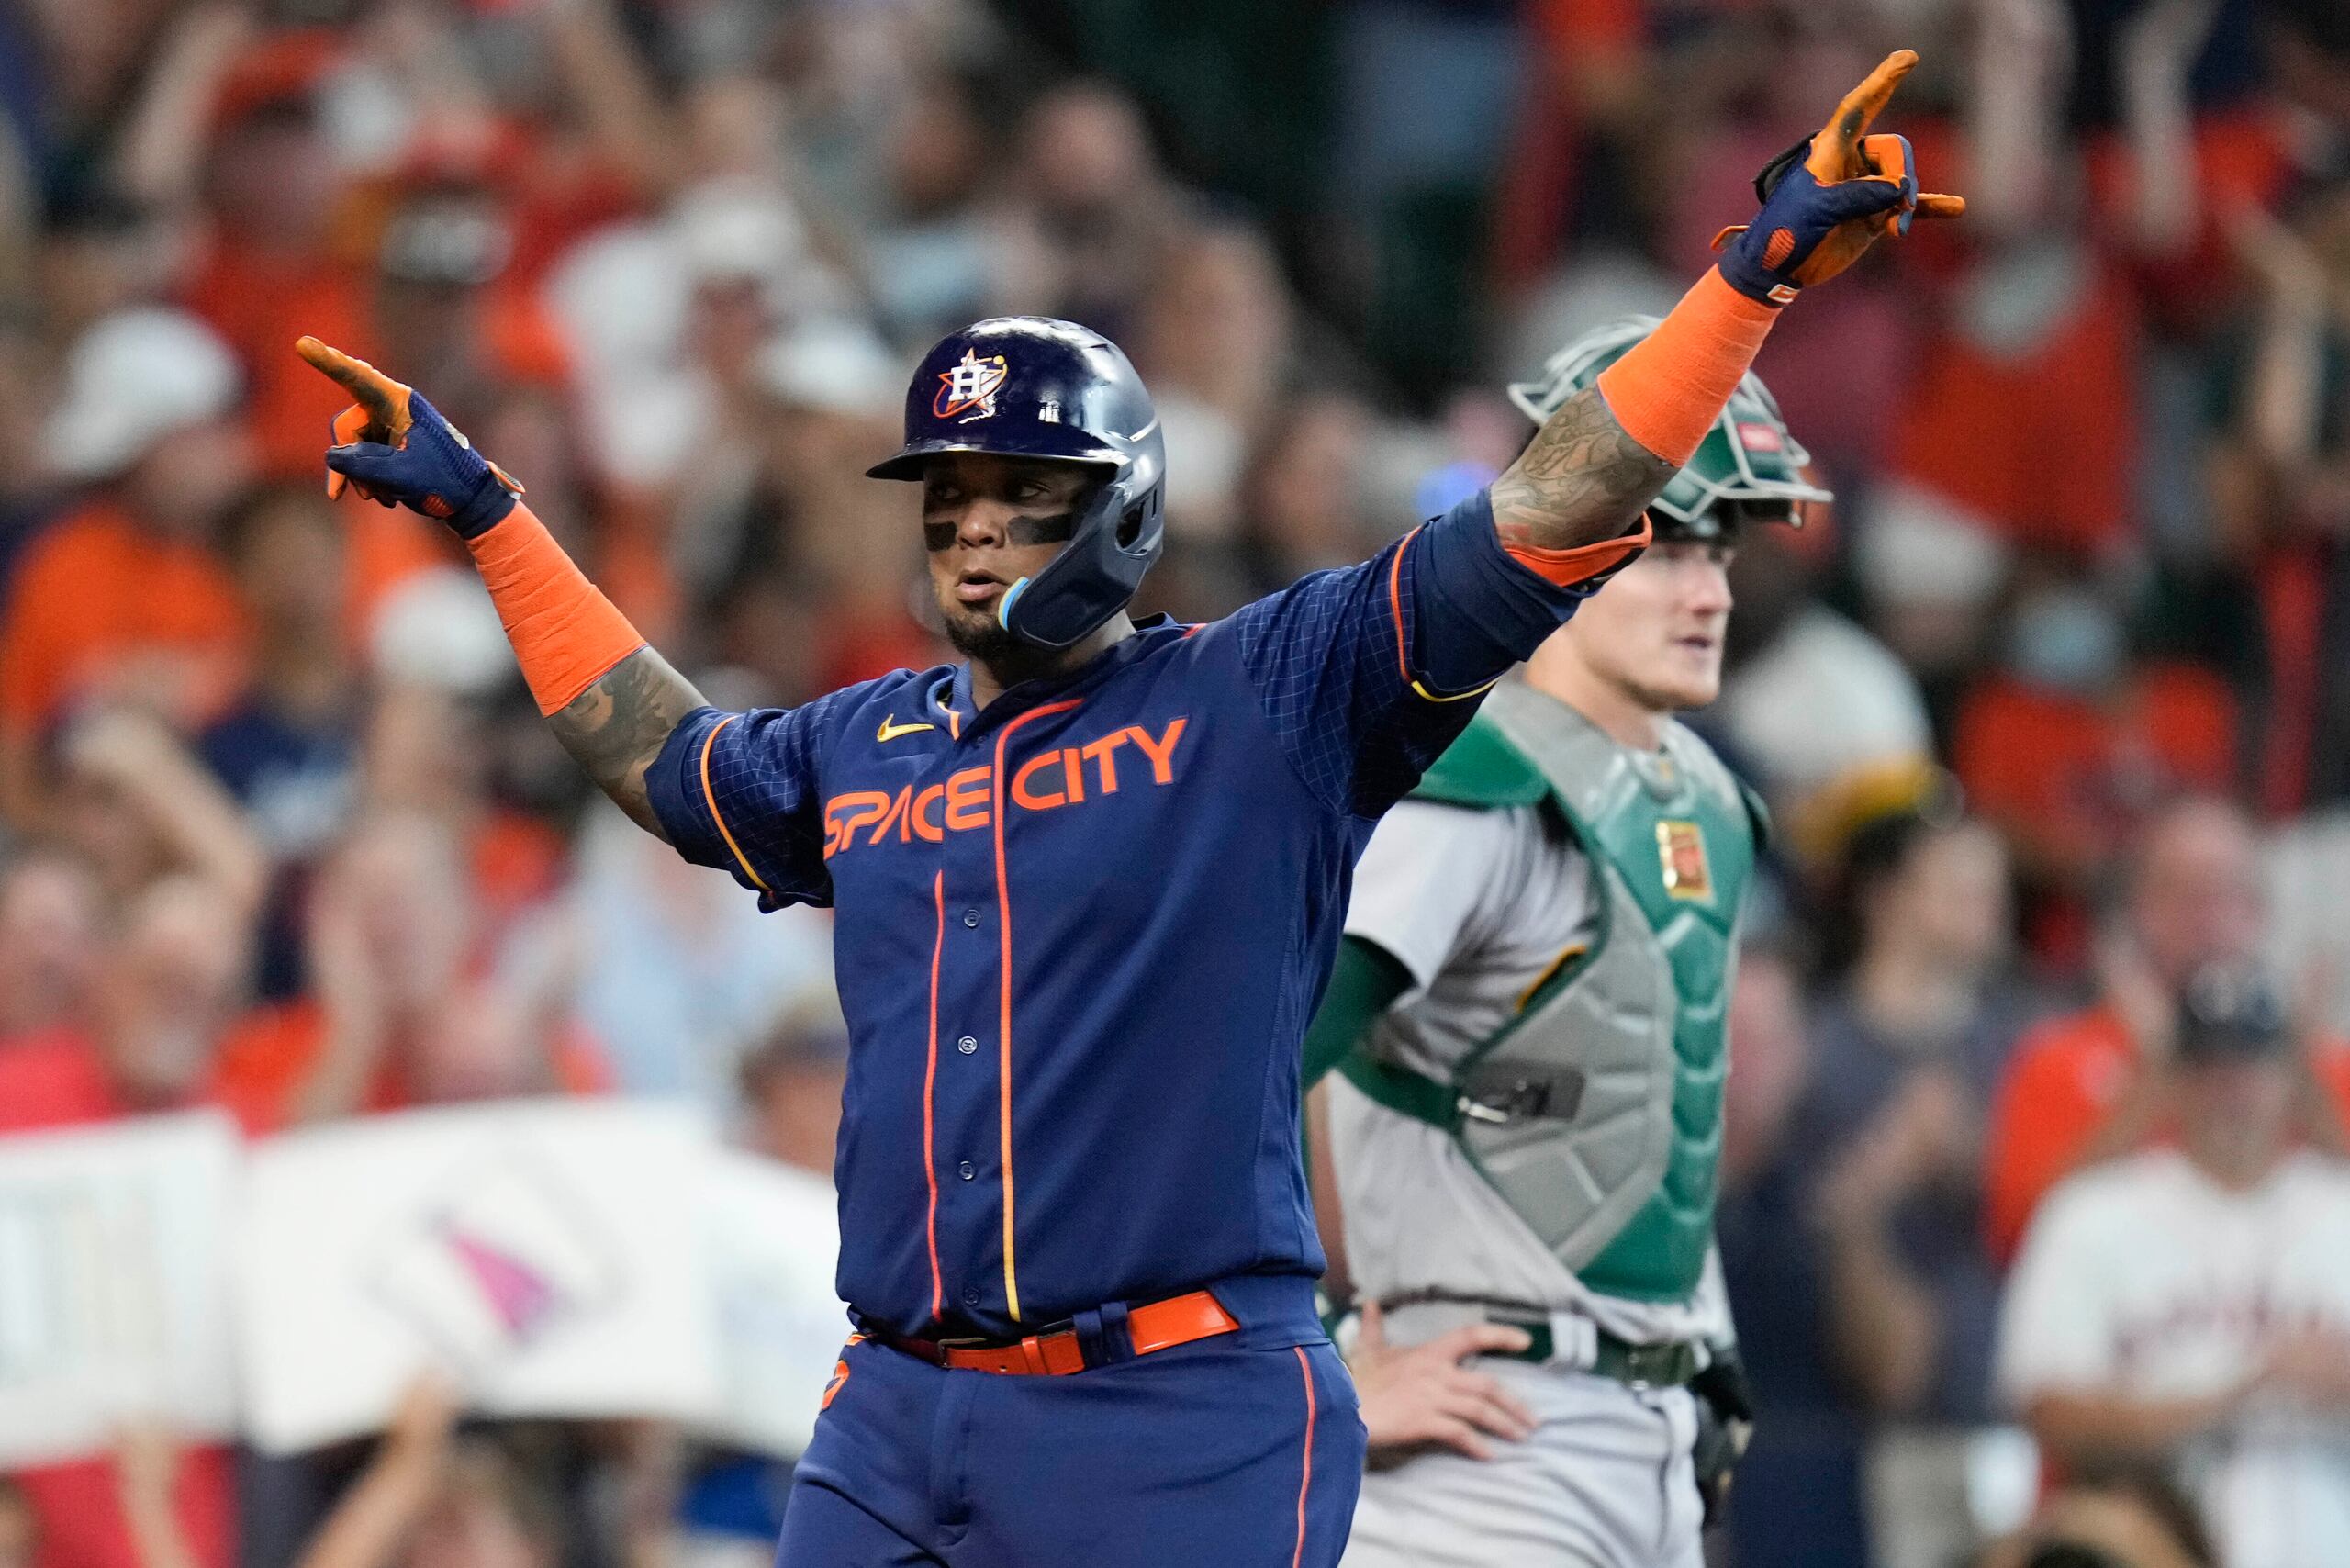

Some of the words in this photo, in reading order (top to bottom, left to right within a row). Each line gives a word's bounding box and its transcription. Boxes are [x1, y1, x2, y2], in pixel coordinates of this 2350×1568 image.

[948, 364, 987, 401] H
[823, 766, 990, 860] SPACE
[1011, 718, 1188, 811] CITY
